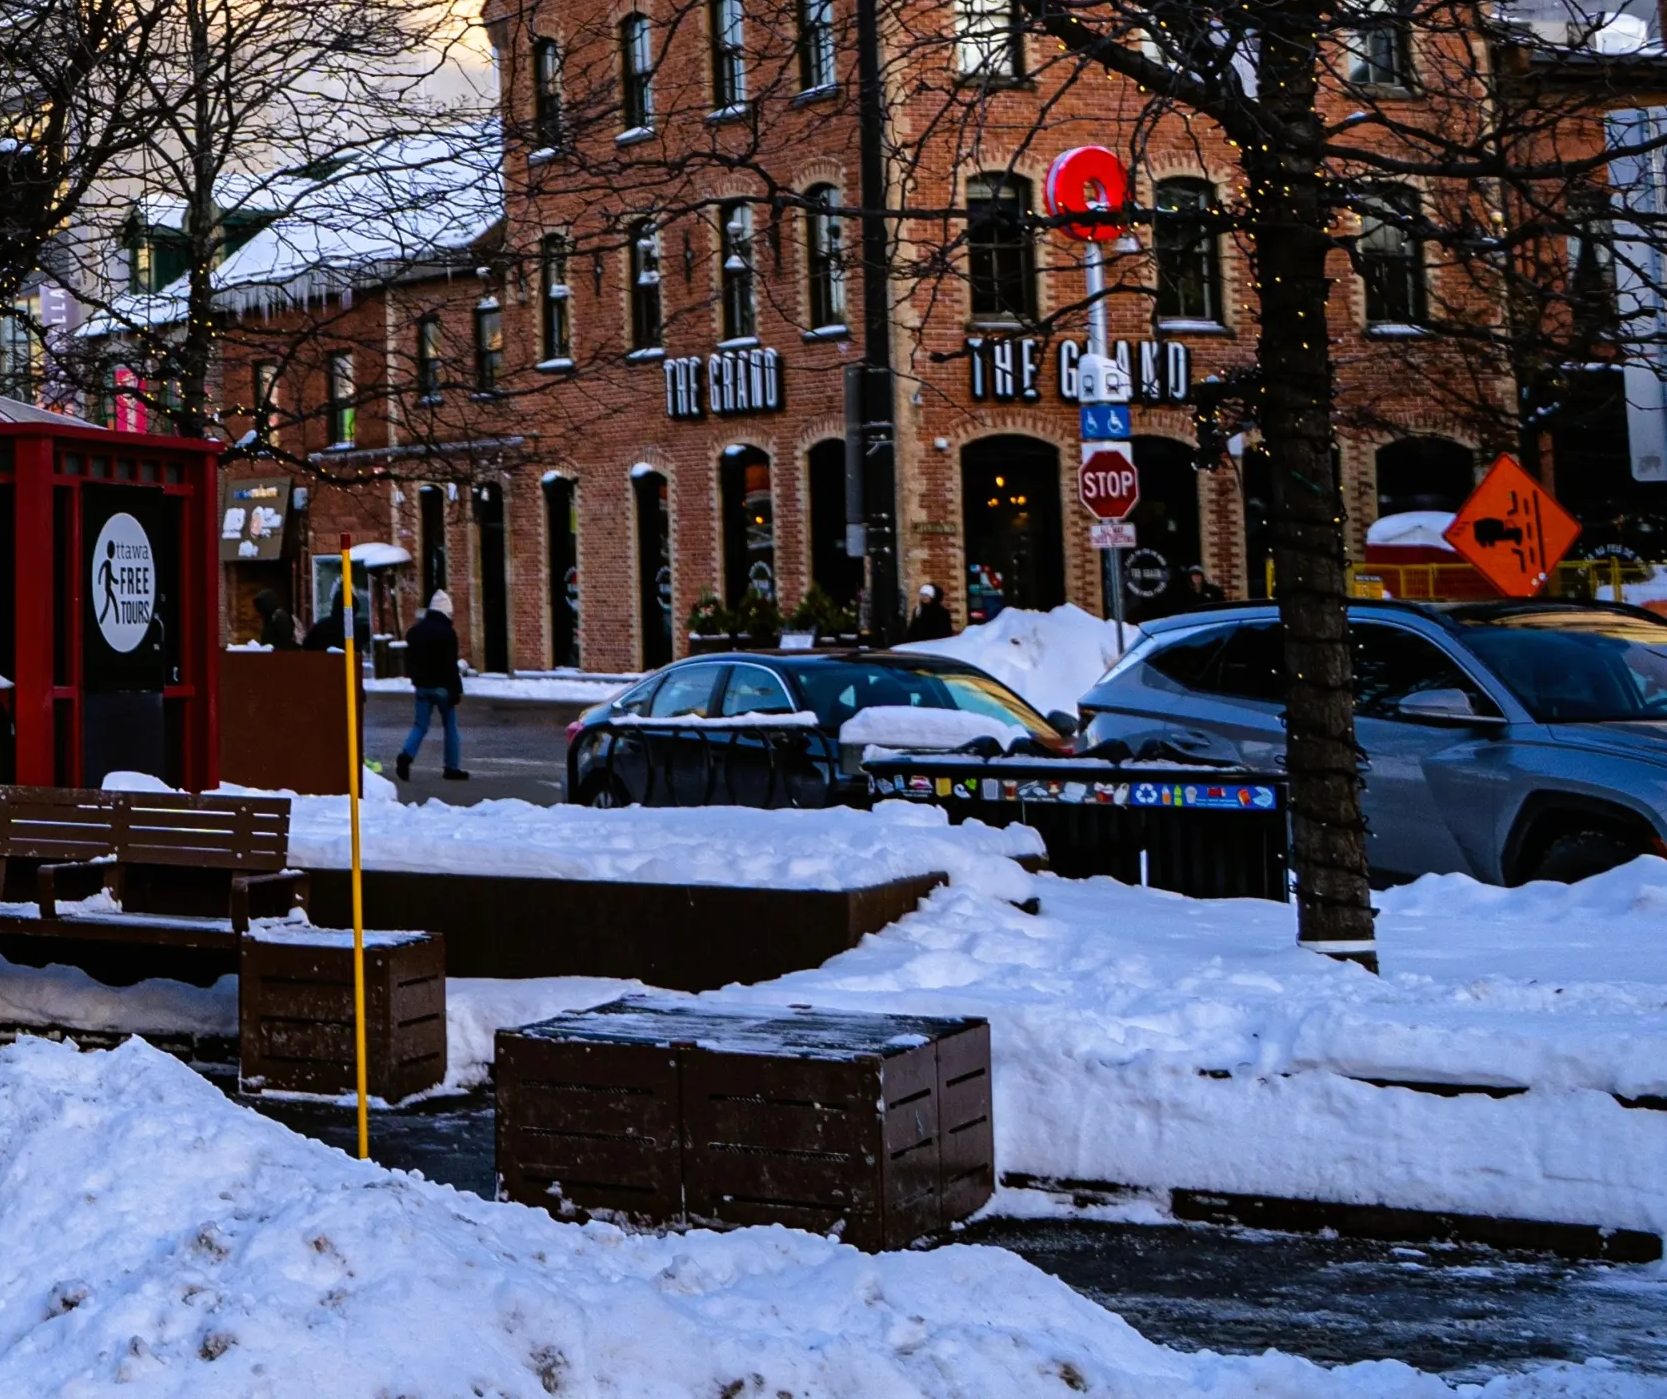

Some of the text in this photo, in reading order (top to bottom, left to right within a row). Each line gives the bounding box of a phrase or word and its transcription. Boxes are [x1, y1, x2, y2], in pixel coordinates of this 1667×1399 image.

[664, 347, 778, 416] THE GRAND
[967, 338, 1188, 400] THE GAND
[1083, 472, 1134, 498] STOP
[120, 567, 149, 595] FREE
[121, 601, 150, 624] TOURS
